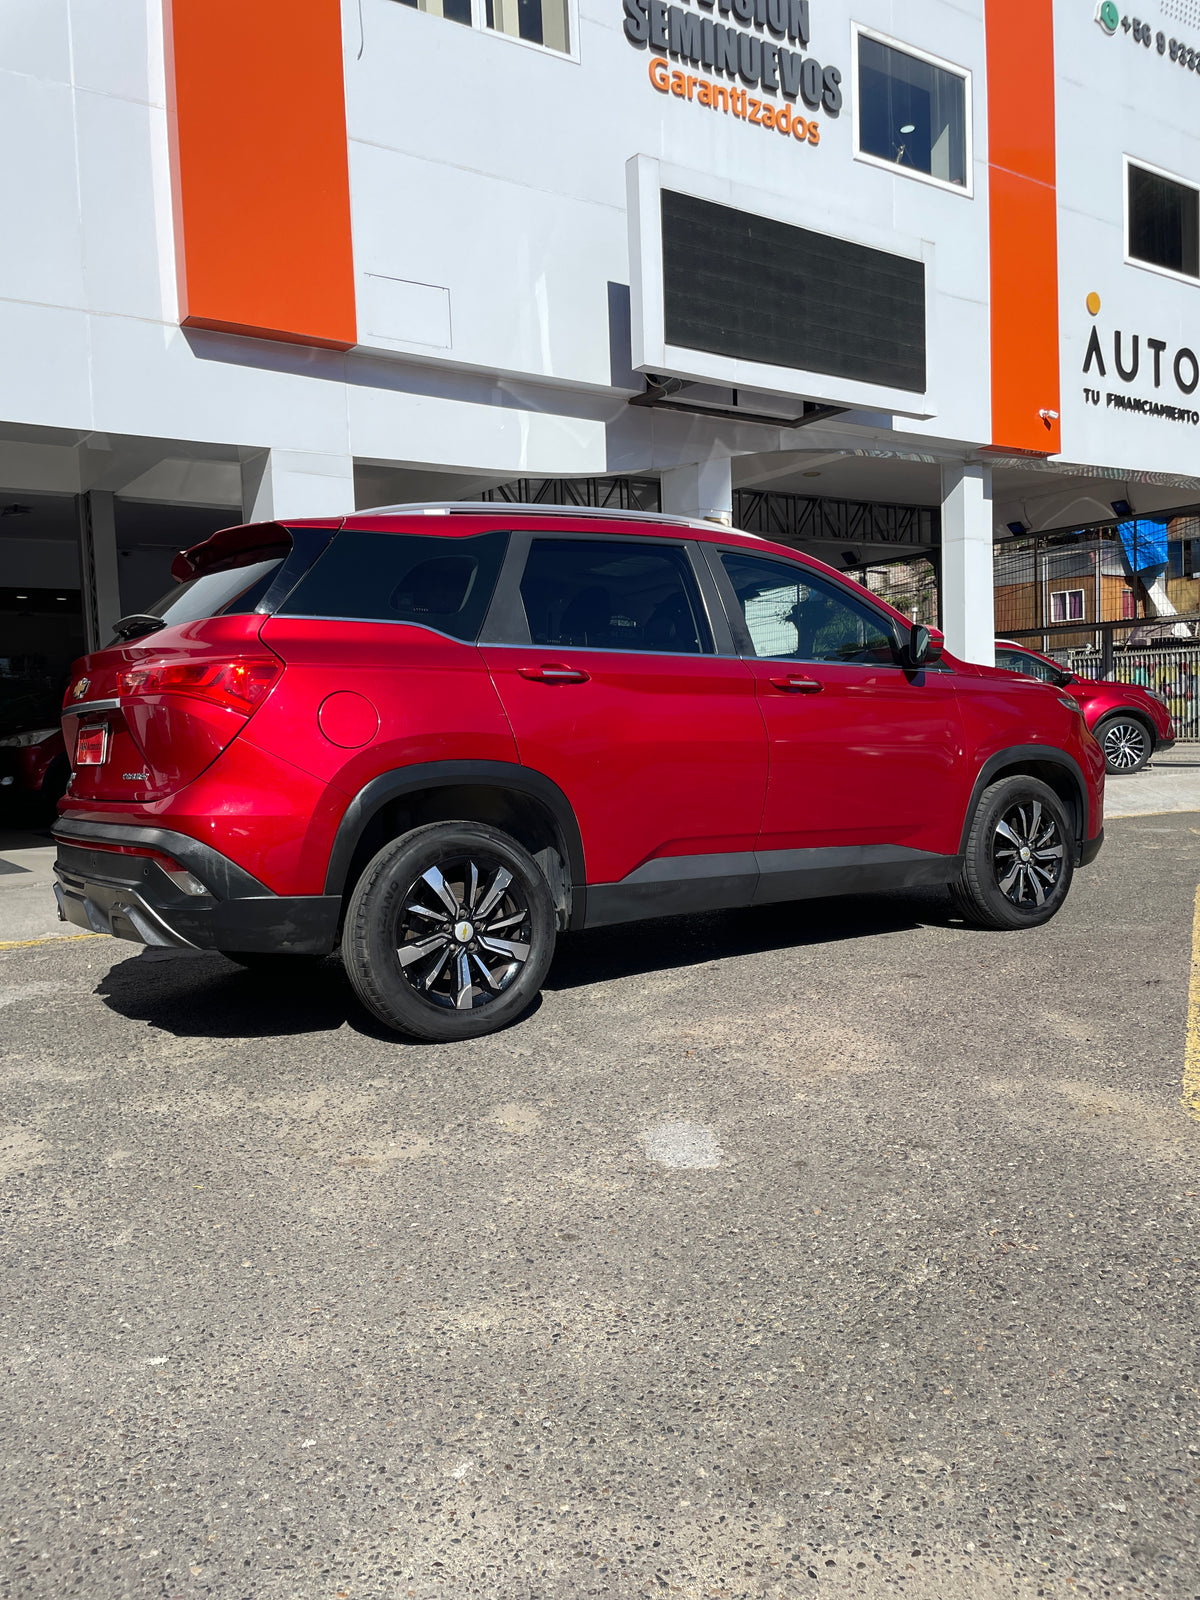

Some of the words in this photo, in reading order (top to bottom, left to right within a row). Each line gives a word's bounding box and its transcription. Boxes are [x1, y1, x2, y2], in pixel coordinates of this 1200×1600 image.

[622, 0, 843, 118] SEMINUEVOS
[1120, 15, 1151, 48] +56
[648, 57, 821, 146] Garantizados
[1083, 388, 1100, 406] TU
[1106, 393, 1199, 425] FINANCIAMIENTO
